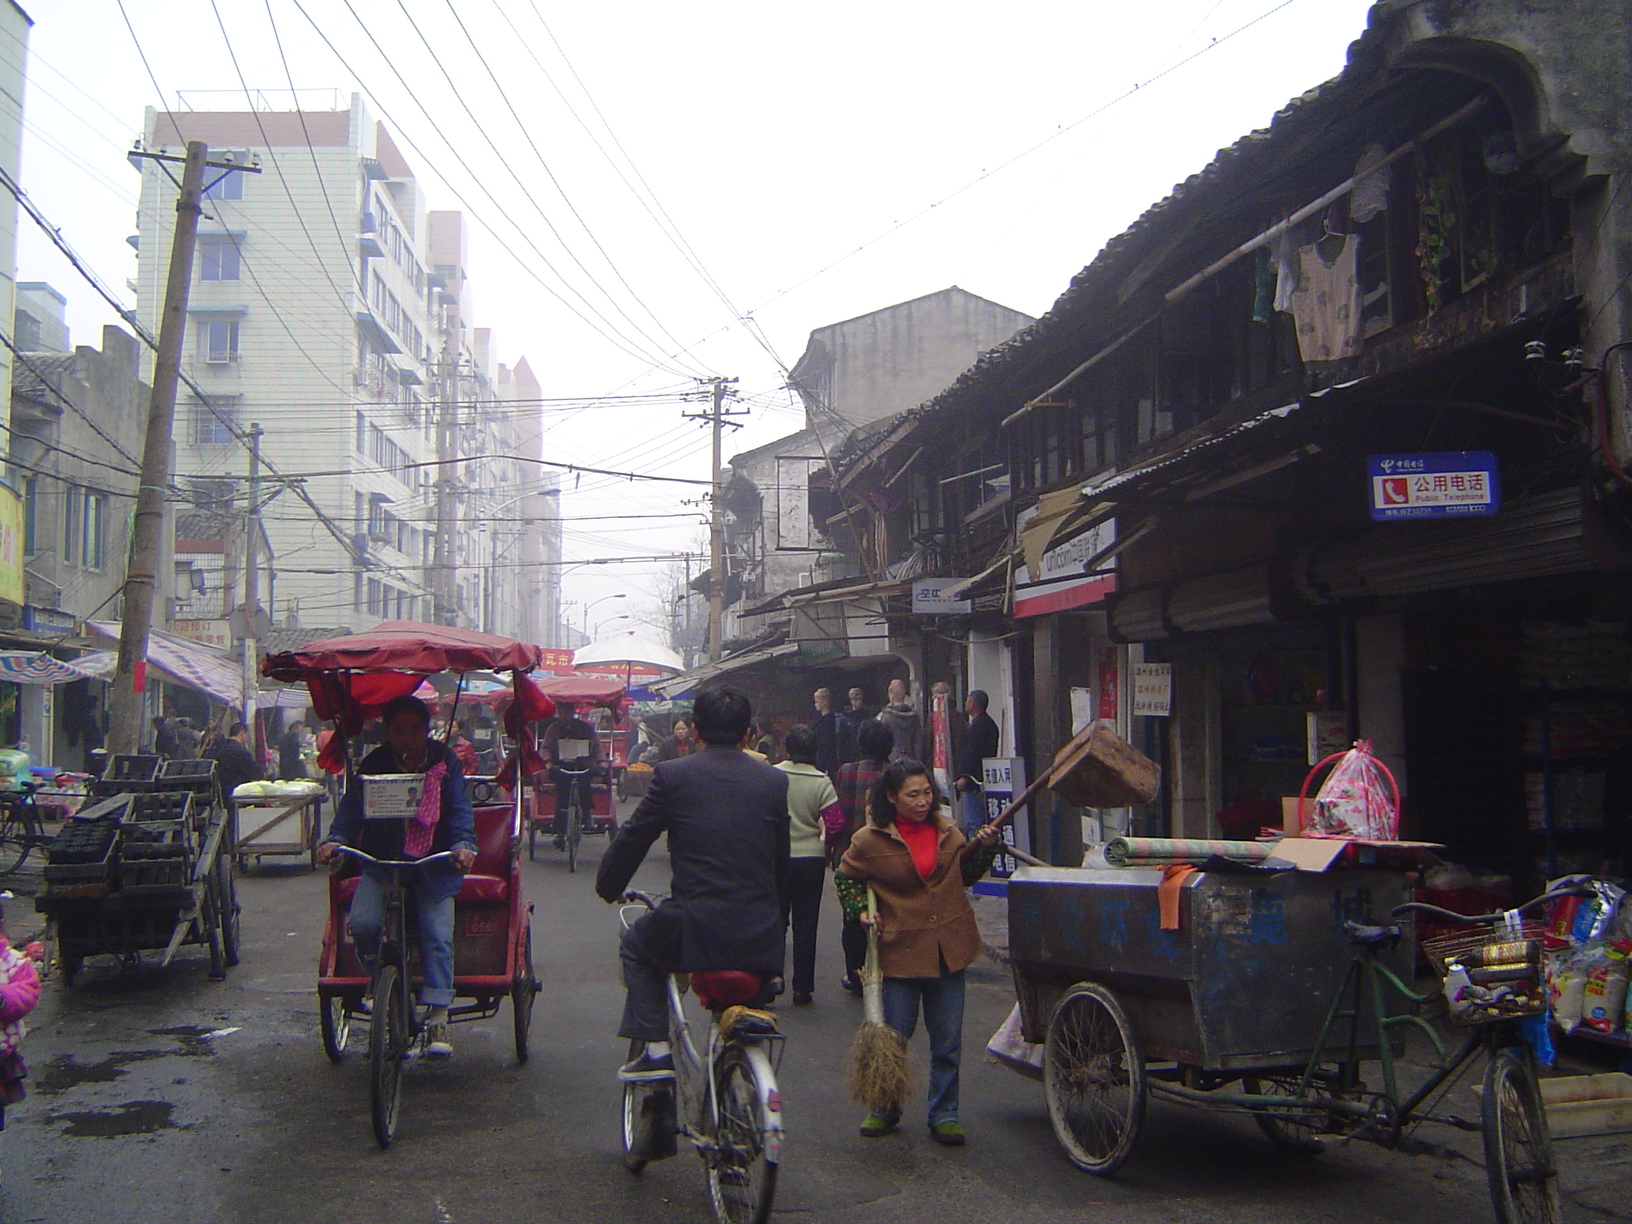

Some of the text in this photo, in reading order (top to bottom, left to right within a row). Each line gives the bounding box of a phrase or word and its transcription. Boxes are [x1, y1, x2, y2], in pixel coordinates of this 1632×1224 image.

[1415, 474, 1483, 493] 公用电话
[1416, 493, 1484, 502] Public Telephone
[985, 768, 1011, 784] 充值入网
[992, 853, 1015, 872] 电信
